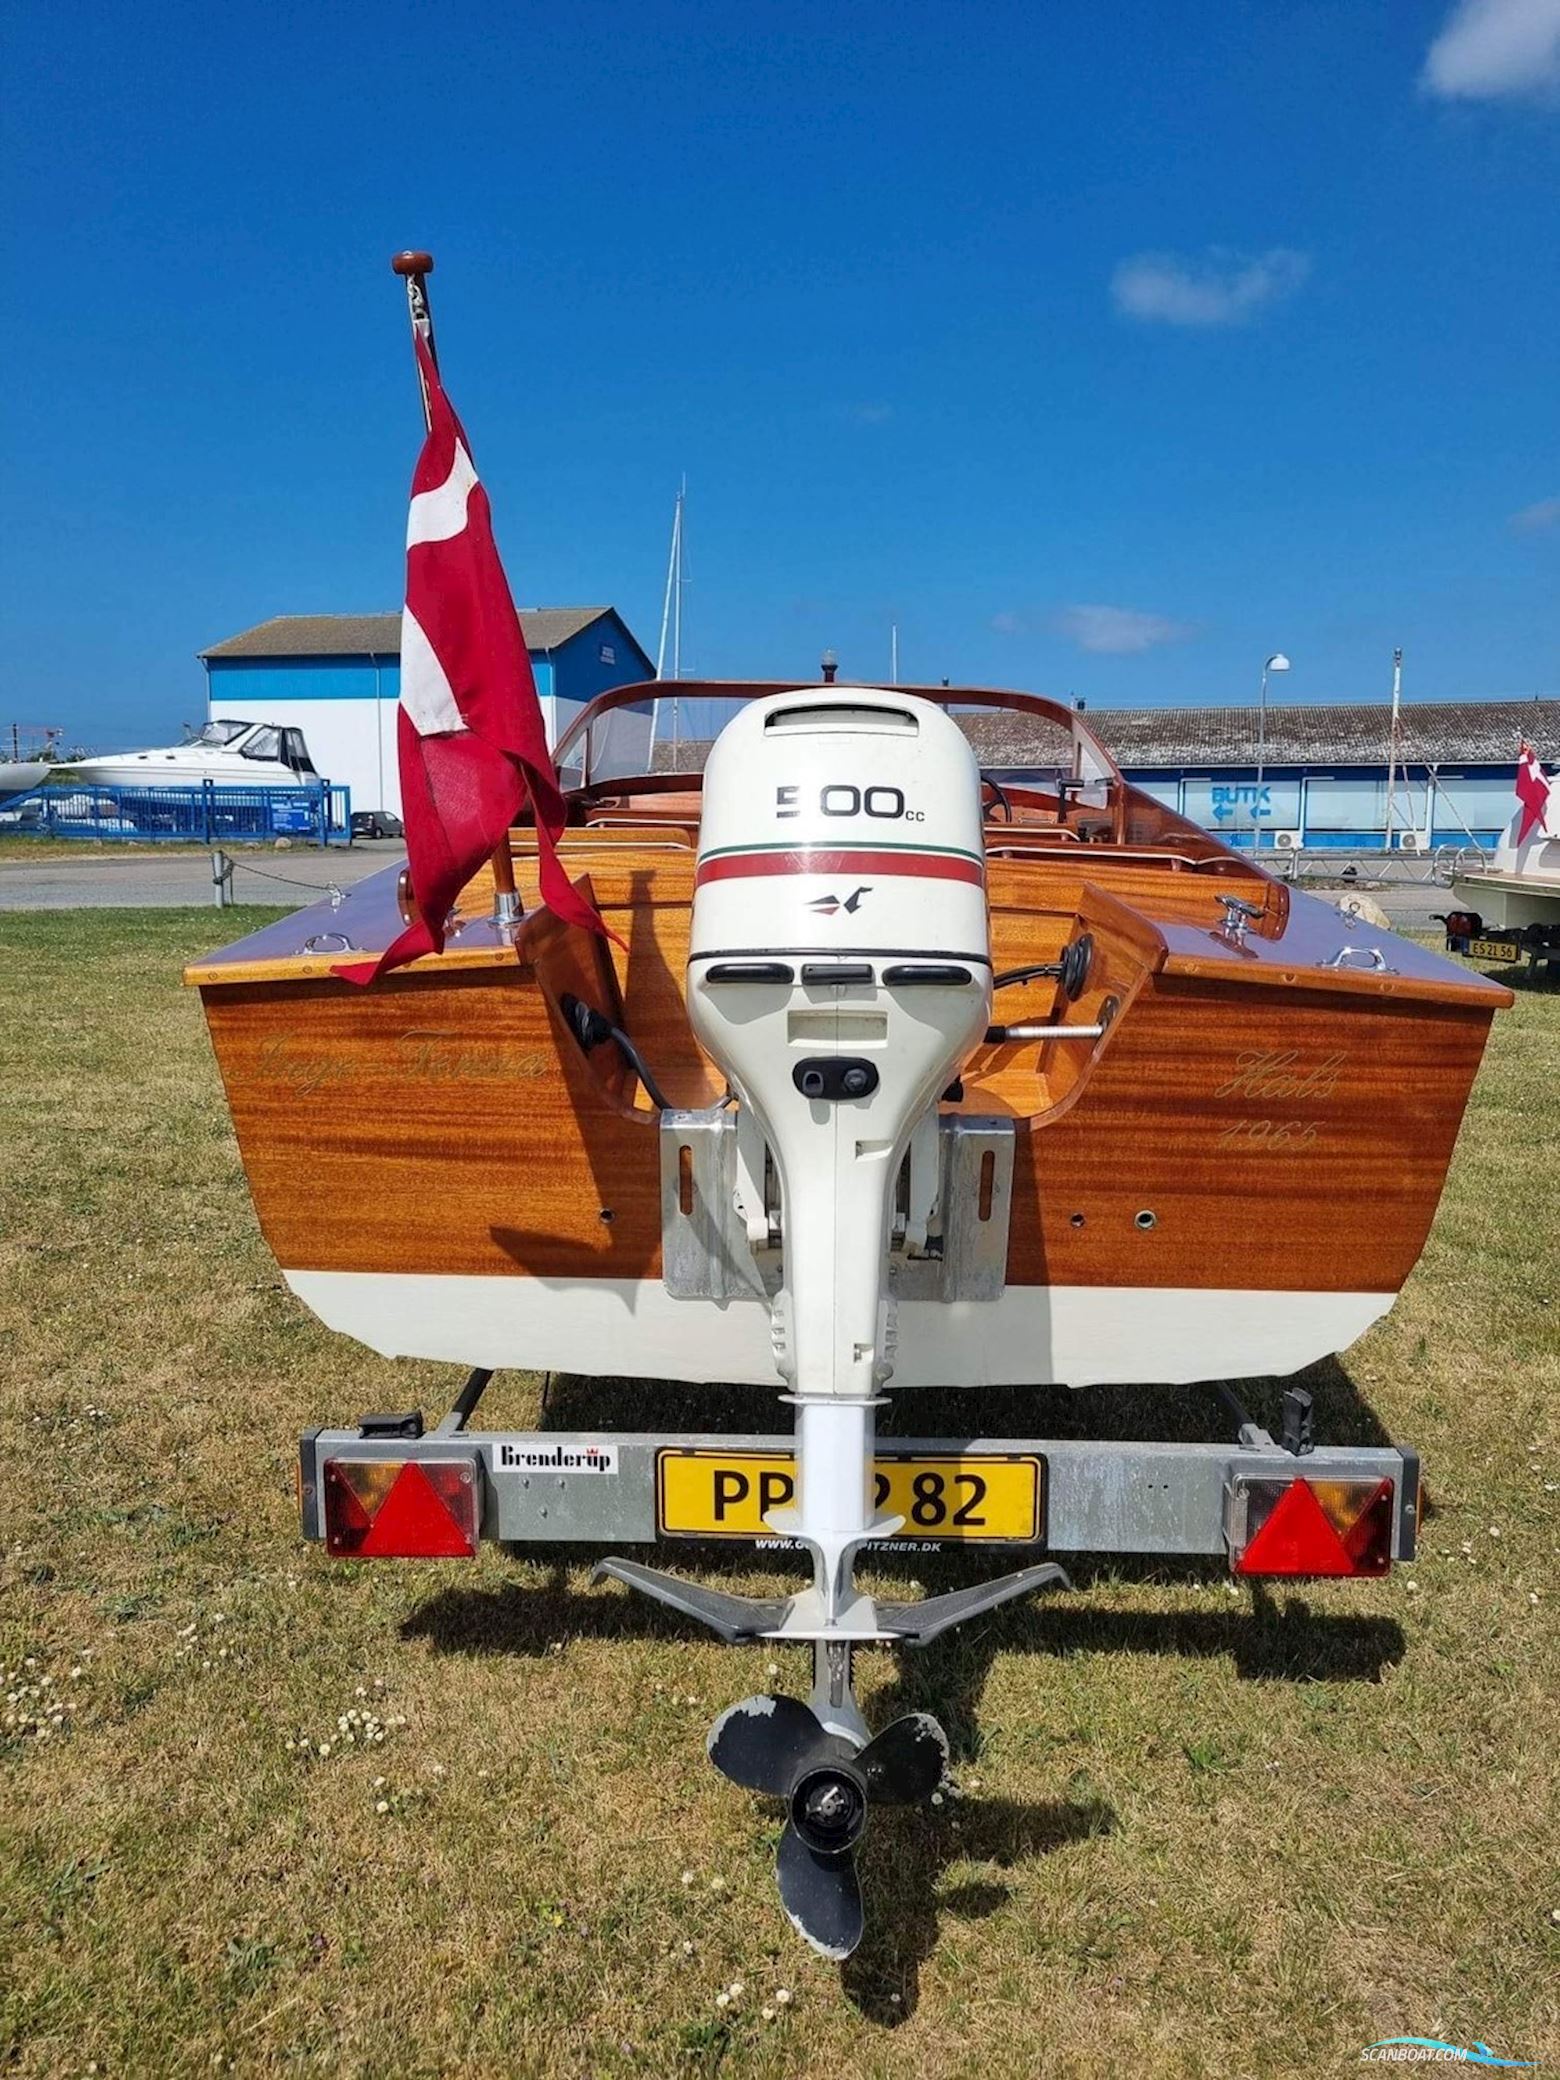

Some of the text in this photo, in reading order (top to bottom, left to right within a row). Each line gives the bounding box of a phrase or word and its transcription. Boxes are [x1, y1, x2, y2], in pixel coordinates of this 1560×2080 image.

[1212, 786, 1271, 804] BUTIK
[1473, 943, 1486, 955] ES
[1218, 1119, 1326, 1150] 1965
[501, 1445, 611, 1472] Brenderup
[713, 1469, 794, 1521] PP
[911, 1472, 987, 1526] 82
